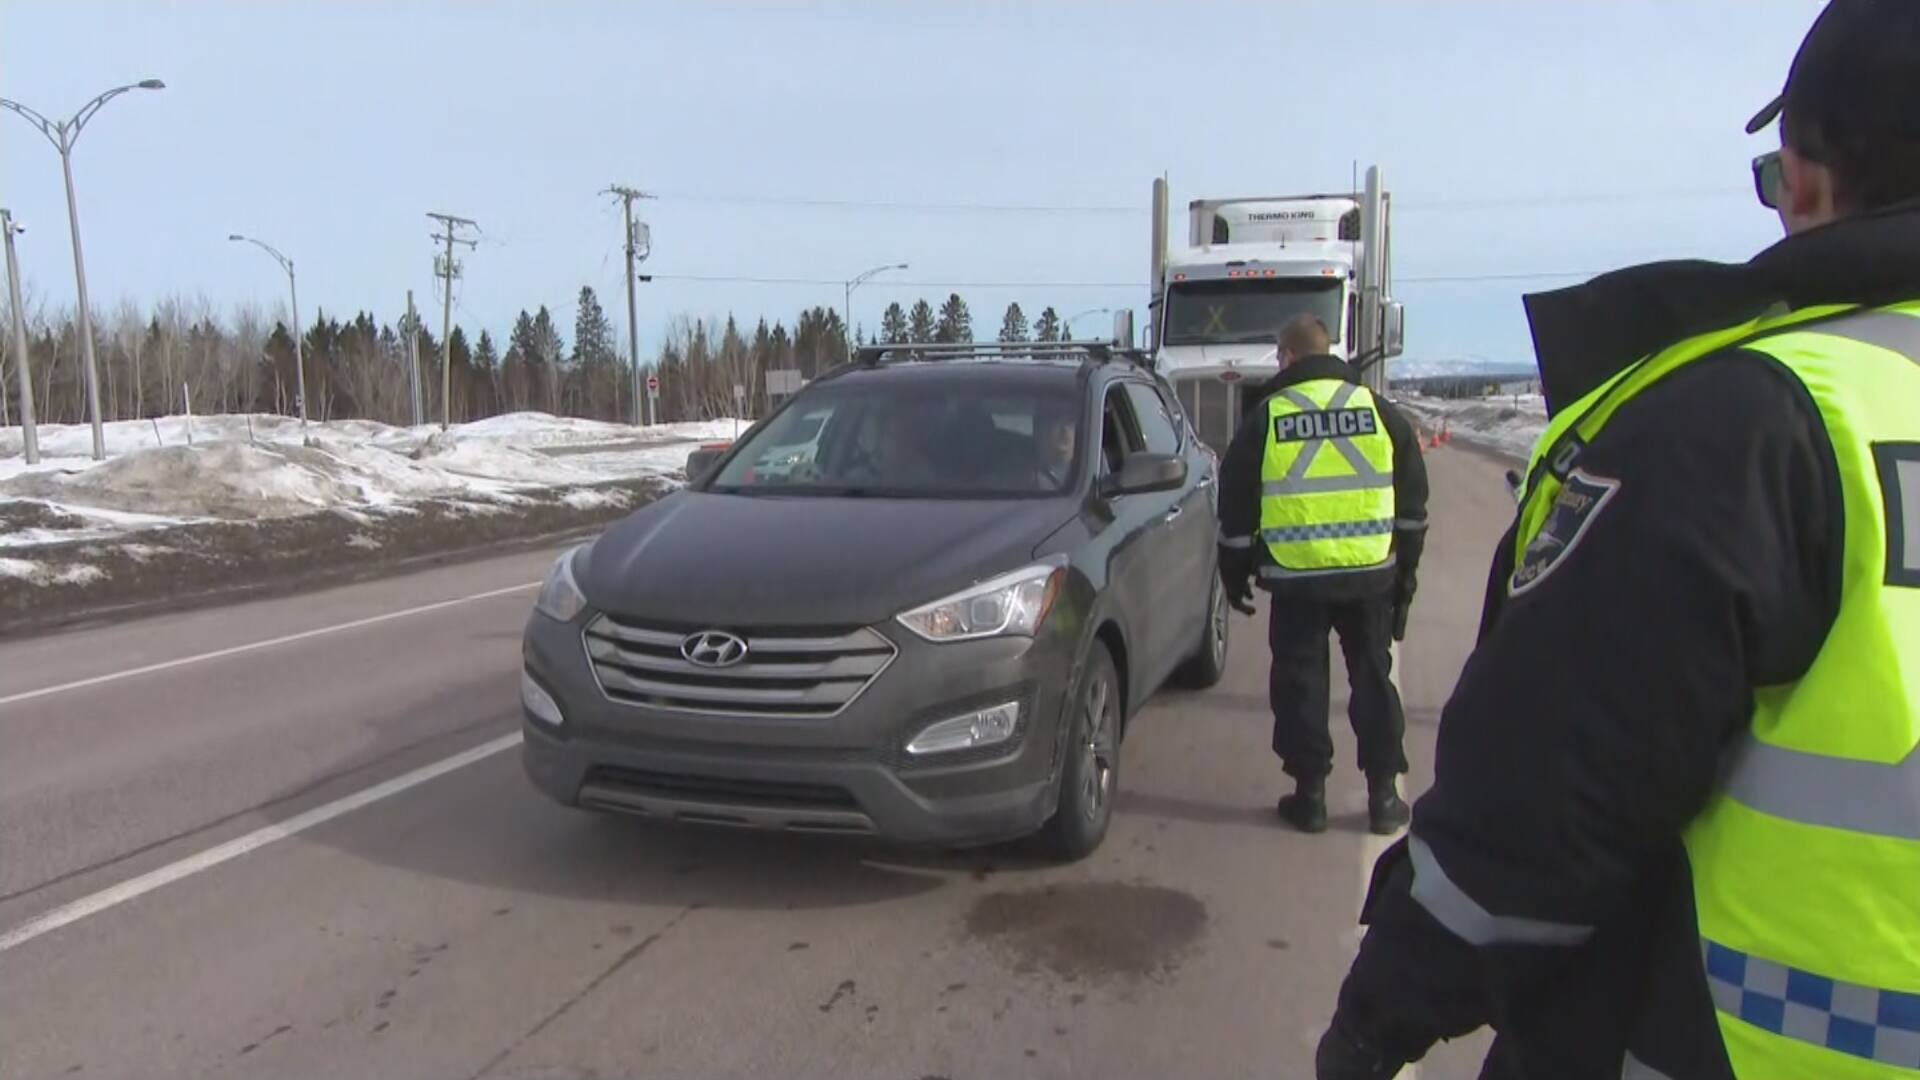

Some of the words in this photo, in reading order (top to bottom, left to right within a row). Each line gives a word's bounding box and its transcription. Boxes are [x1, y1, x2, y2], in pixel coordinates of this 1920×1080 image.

[1248, 212, 1289, 221] THERMO
[1290, 210, 1315, 220] KING
[1277, 409, 1375, 440] POLICE
